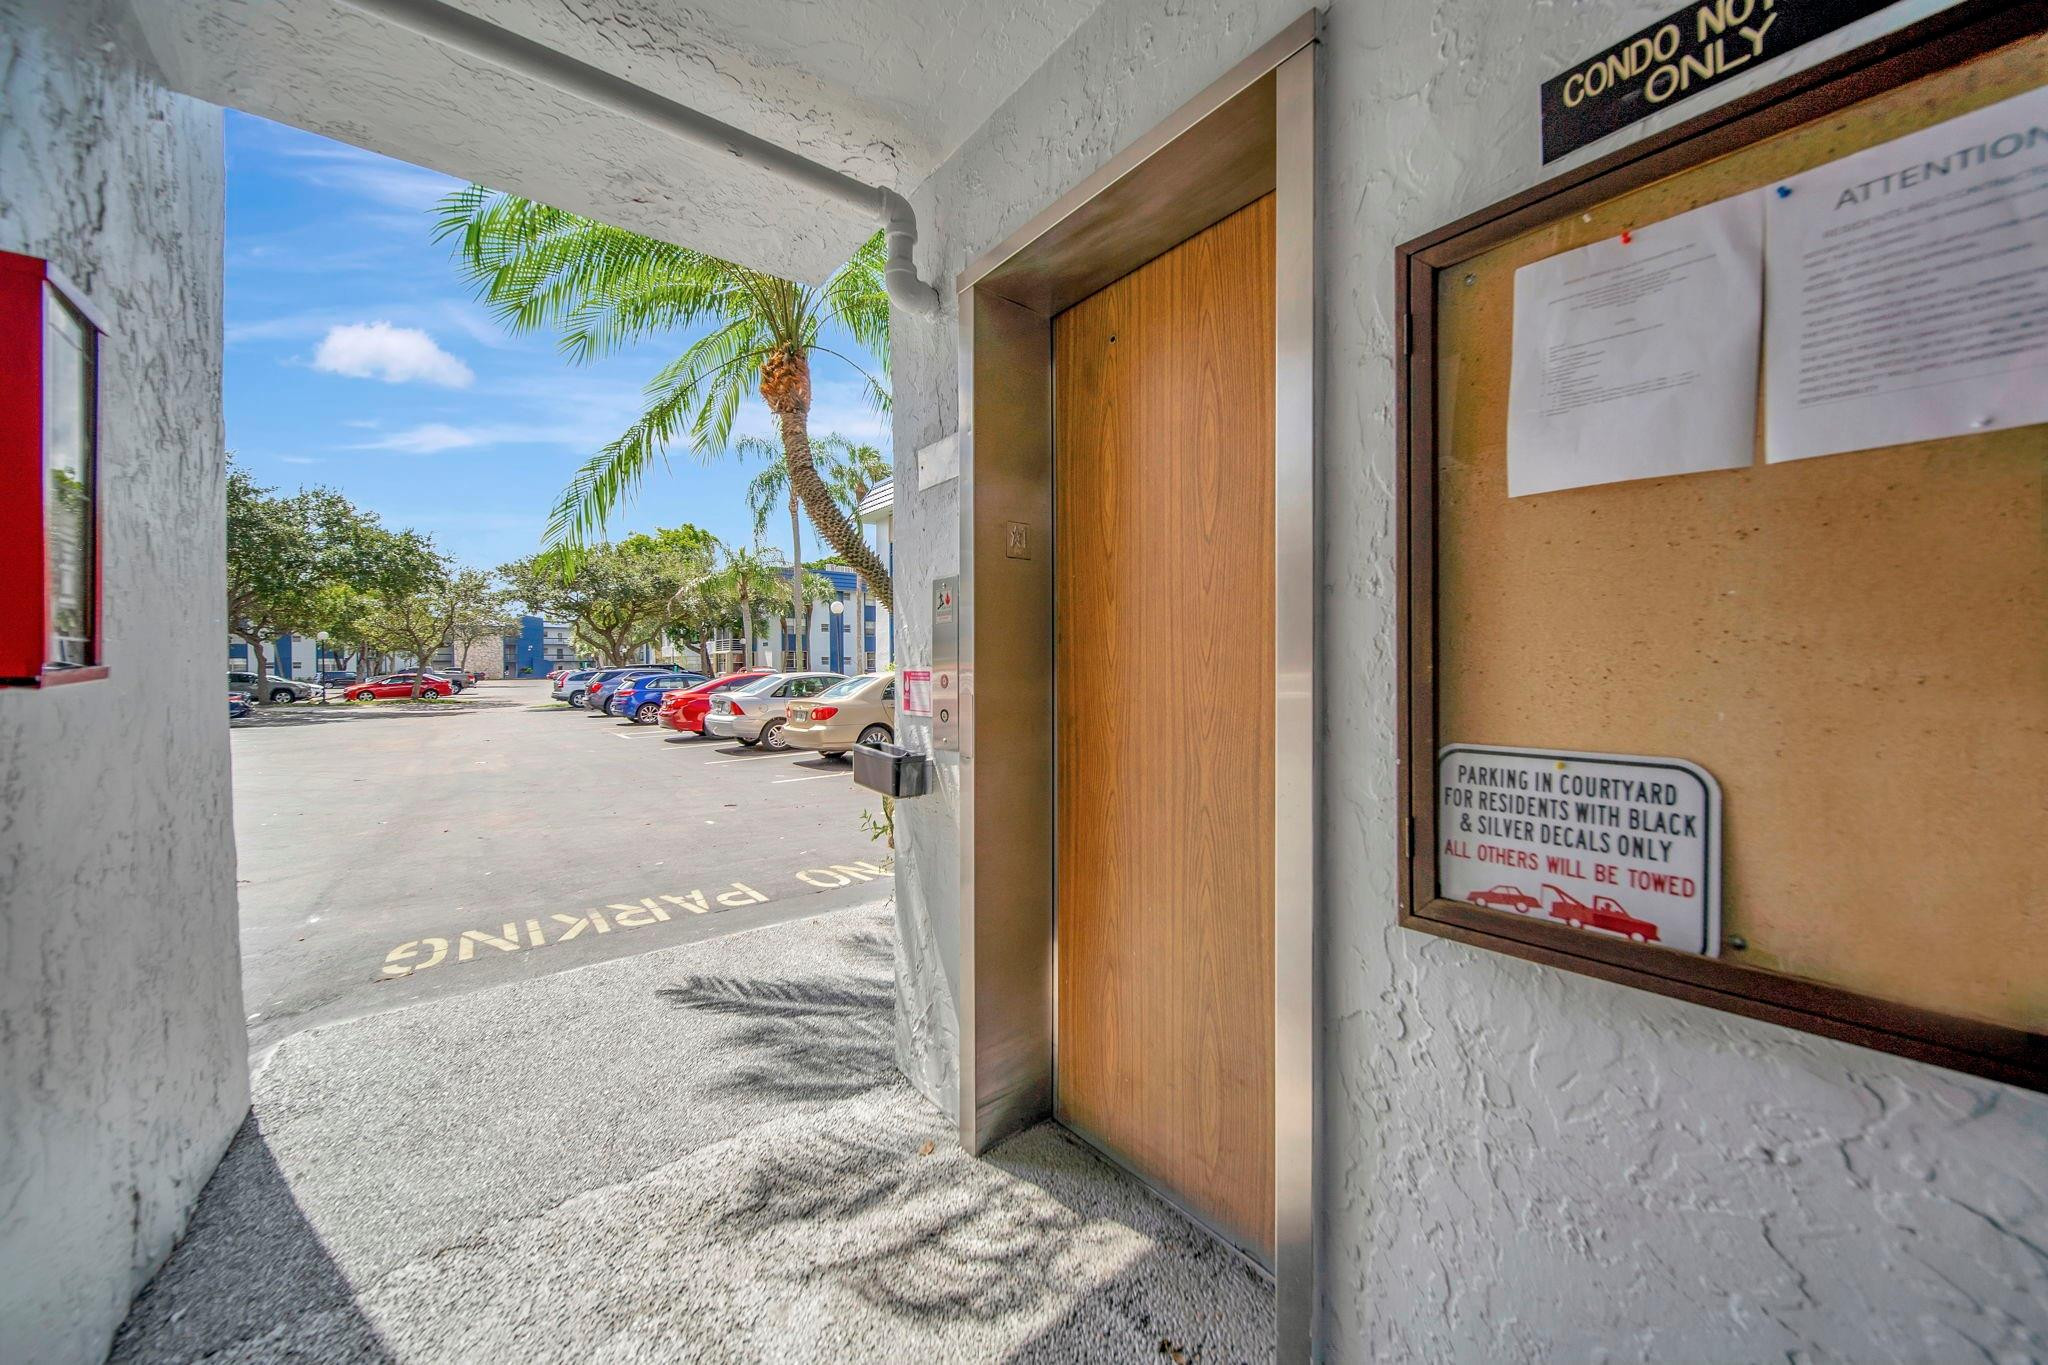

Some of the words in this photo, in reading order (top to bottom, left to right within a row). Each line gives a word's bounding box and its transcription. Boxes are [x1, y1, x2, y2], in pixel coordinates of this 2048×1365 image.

[1563, 24, 1680, 108] CONDO
[1697, 0, 1774, 43] NO
[1645, 12, 1778, 103] ONLY
[1444, 786, 1473, 809] FOR
[1479, 791, 1568, 821] RESIDENTS
[1575, 802, 1620, 828] WITH
[1629, 808, 1697, 838] BLACK
[1458, 764, 1528, 791] PARKING
[1534, 772, 1552, 794] IN
[1560, 773, 1677, 806] COURTYARD
[1460, 813, 1472, 832] &
[1478, 815, 1534, 842] SILVER
[1540, 824, 1610, 854] DECALS
[1618, 834, 1673, 863] ONLY
[795, 861, 895, 888] NO
[1444, 839, 1471, 859] ALL
[1477, 844, 1539, 870] OTHERS
[1546, 855, 1587, 880] WILL
[1594, 863, 1619, 885] BE
[1628, 868, 1695, 898] TOWED
[381, 882, 770, 976] PARKING
